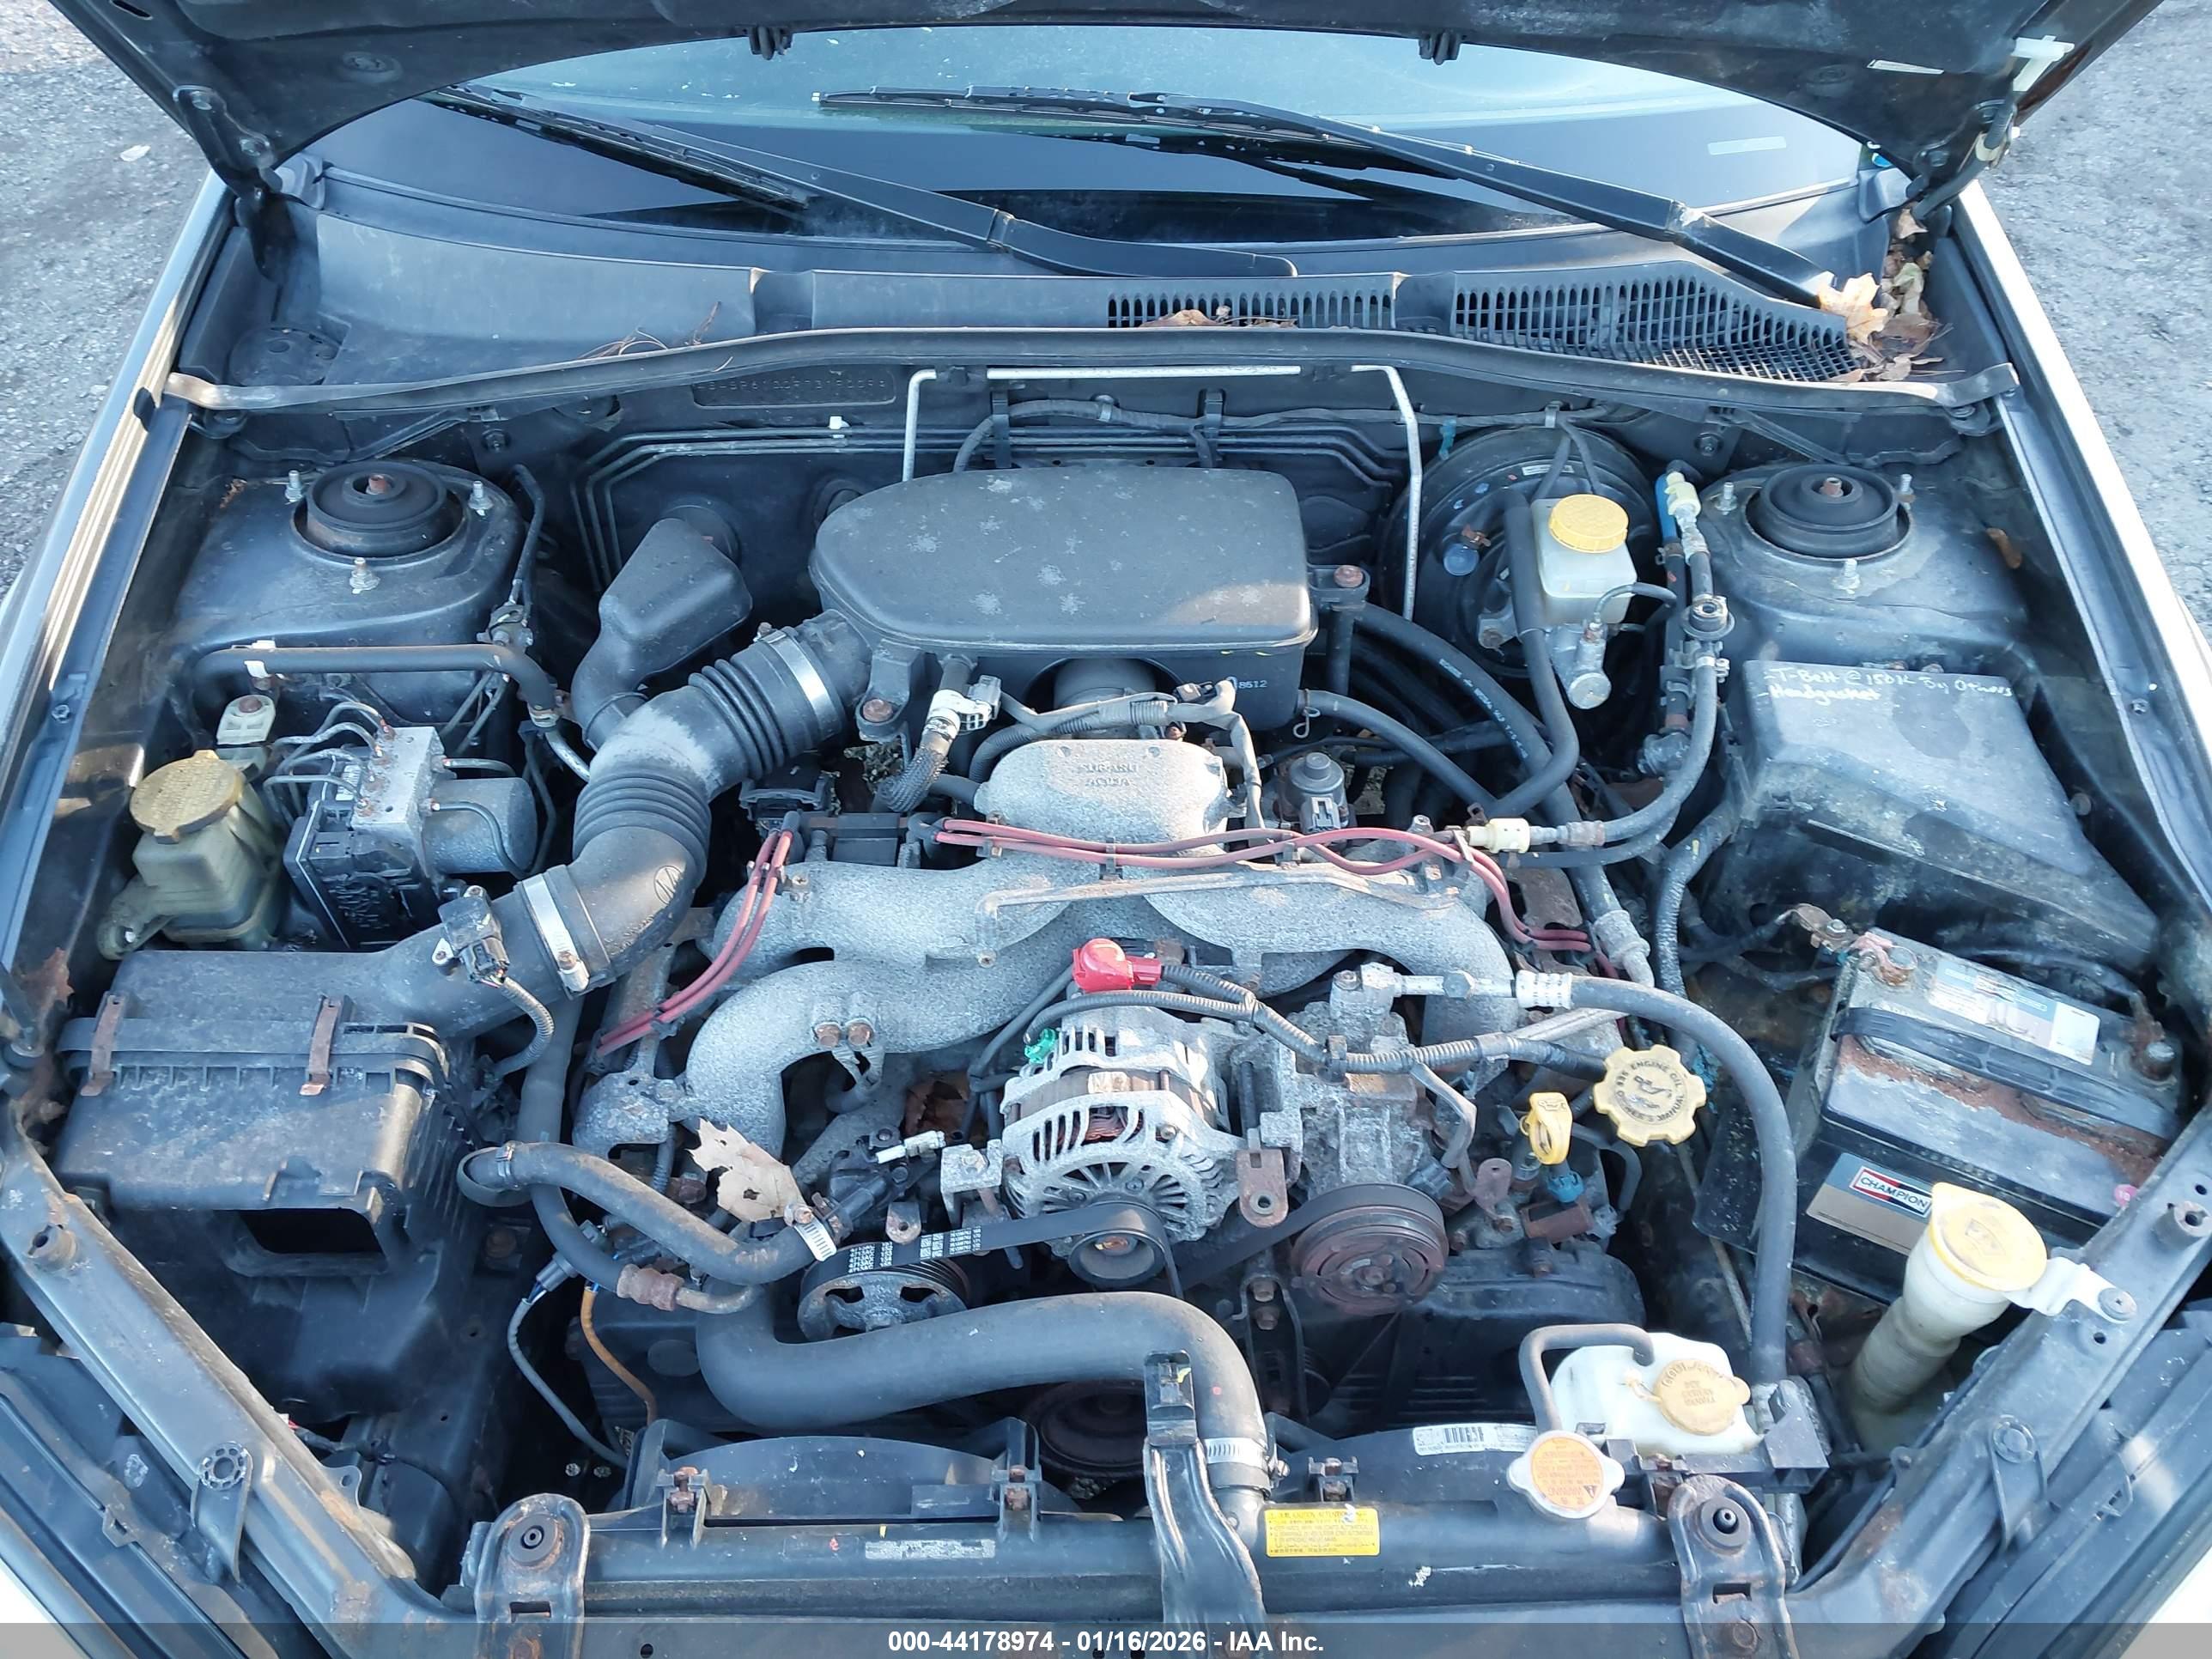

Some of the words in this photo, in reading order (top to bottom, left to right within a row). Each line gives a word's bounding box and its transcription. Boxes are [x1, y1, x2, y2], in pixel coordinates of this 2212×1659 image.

[1844, 671, 1863, 685] @
[1631, 1060, 1670, 1073] ENGINE
[1669, 1073, 1682, 1088] OIL
[1656, 1095, 1686, 1121] MANUAL
[1860, 1176, 1929, 1208] CHAMPION
